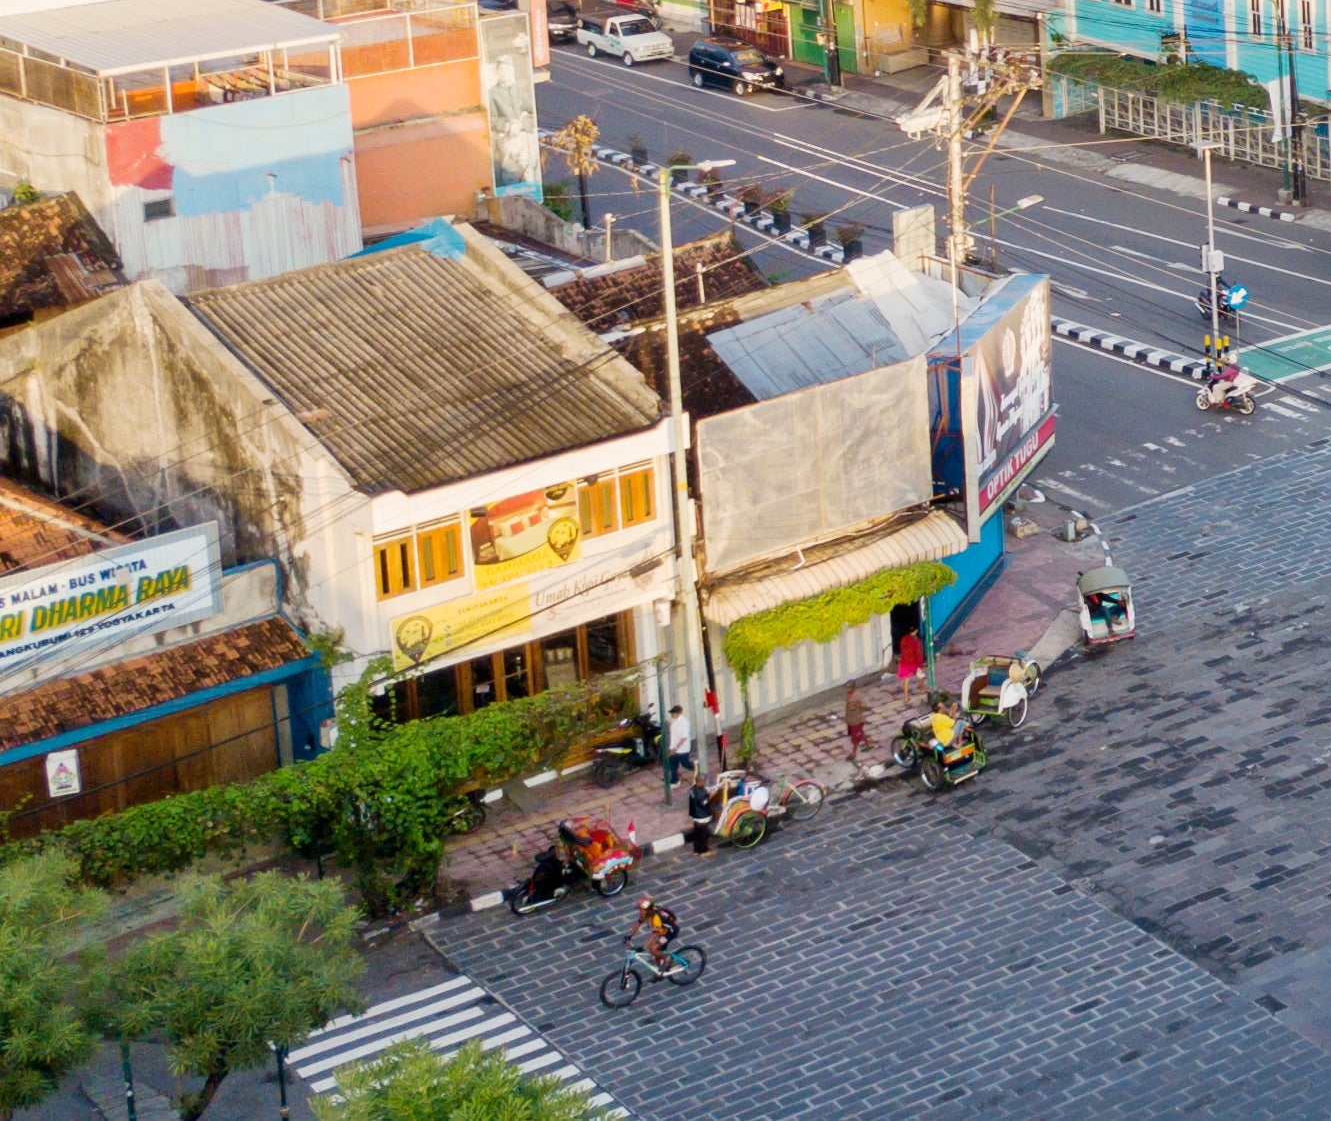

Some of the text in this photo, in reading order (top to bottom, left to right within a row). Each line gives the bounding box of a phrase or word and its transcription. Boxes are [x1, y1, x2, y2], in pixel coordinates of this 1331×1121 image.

[986, 459, 1014, 499] OPTIK
[1014, 431, 1039, 469] TUGU
[11, 583, 58, 605] MALAM
[69, 573, 96, 590] BUS
[100, 559, 148, 581] WITA
[30, 584, 131, 633] DHARMA
[136, 565, 193, 604] RAYA
[95, 603, 176, 630] YOGYAKARTA
